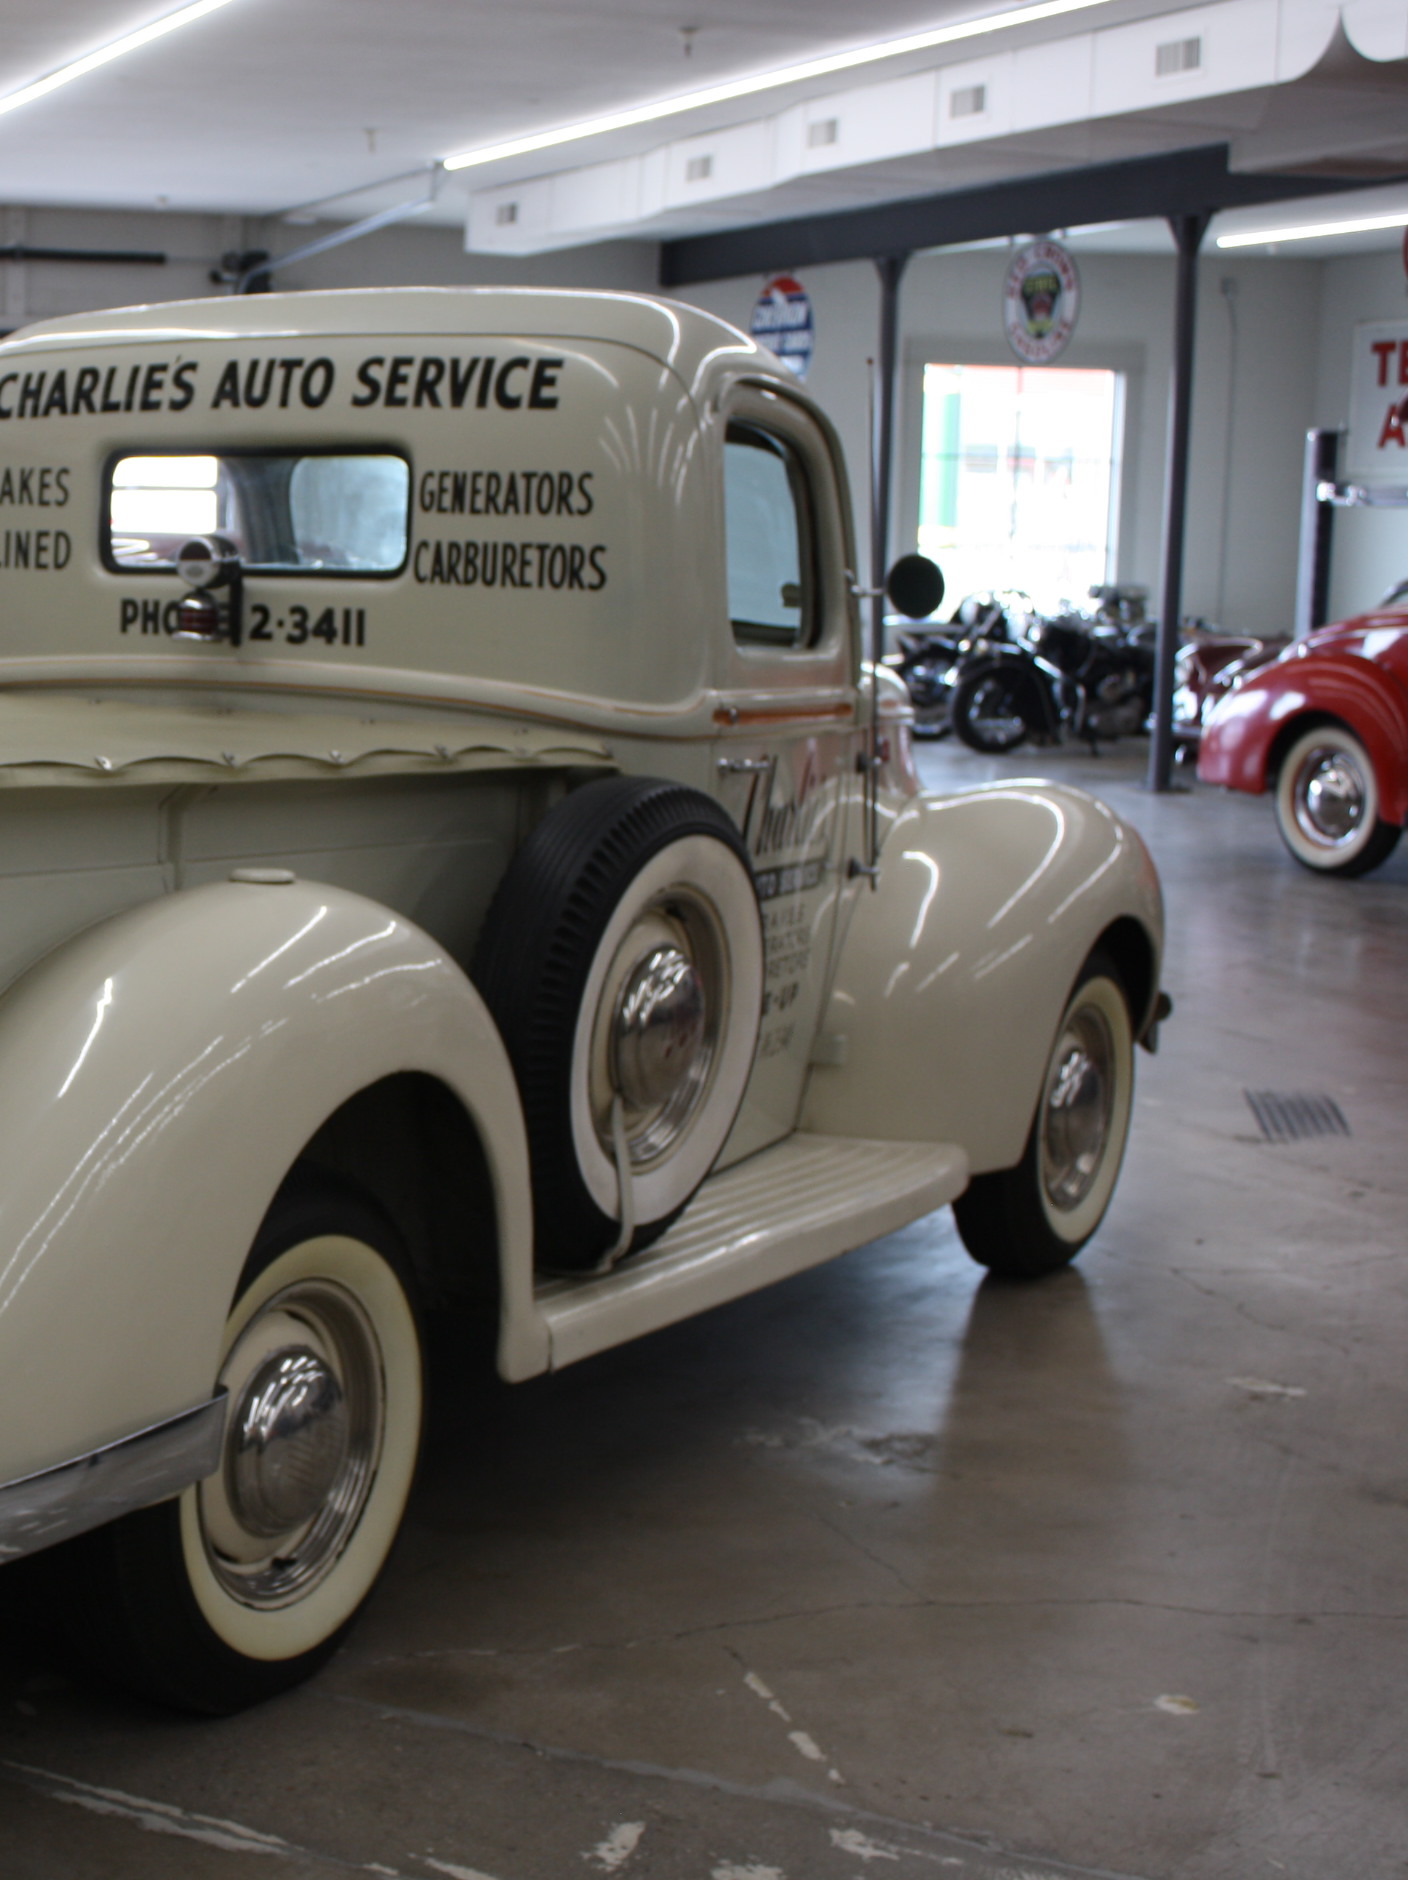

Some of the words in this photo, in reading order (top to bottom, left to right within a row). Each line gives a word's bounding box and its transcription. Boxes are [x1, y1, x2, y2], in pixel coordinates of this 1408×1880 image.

[212, 357, 335, 410] AUTO
[351, 356, 564, 410] SERVICE
[419, 470, 595, 518] GENERATORS
[412, 542, 607, 591] CARBURETORS
